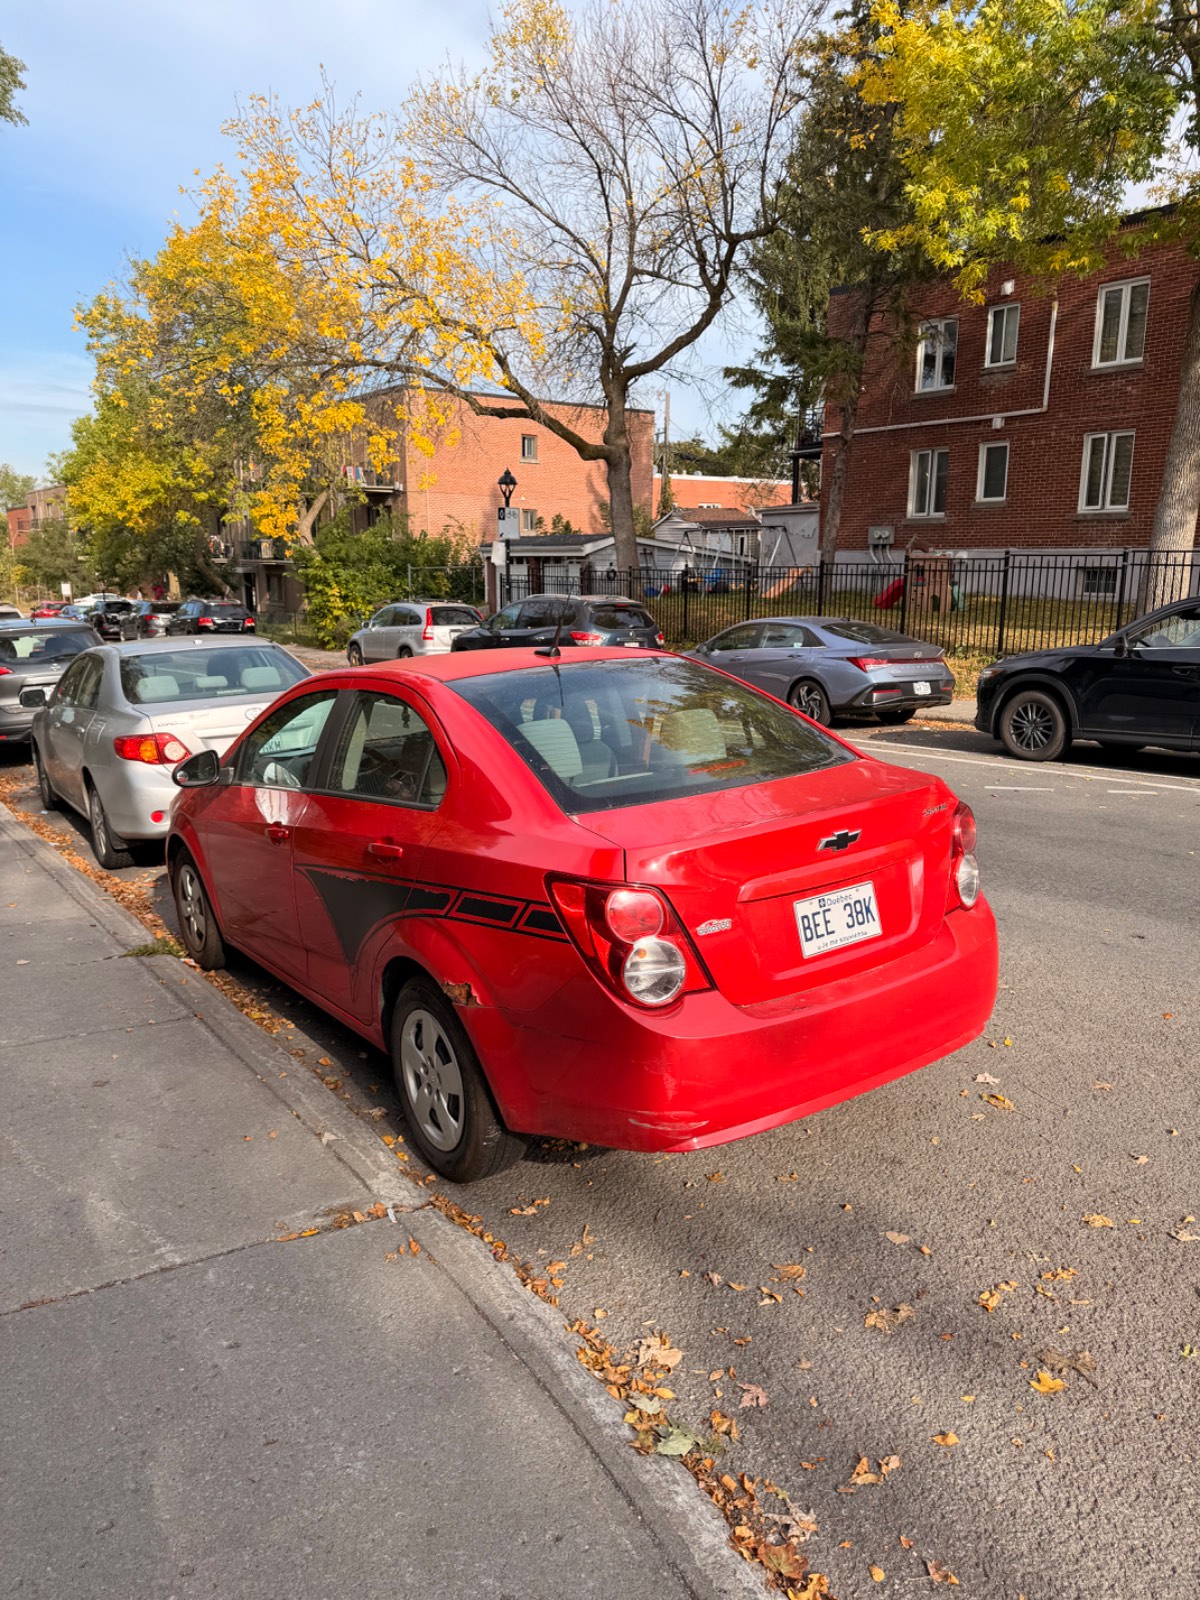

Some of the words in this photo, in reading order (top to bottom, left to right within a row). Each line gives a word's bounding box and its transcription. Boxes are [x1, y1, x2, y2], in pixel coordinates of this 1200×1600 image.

[826, 893, 853, 907] Québec
[800, 908, 836, 943] BEE
[843, 896, 876, 929] 38K
